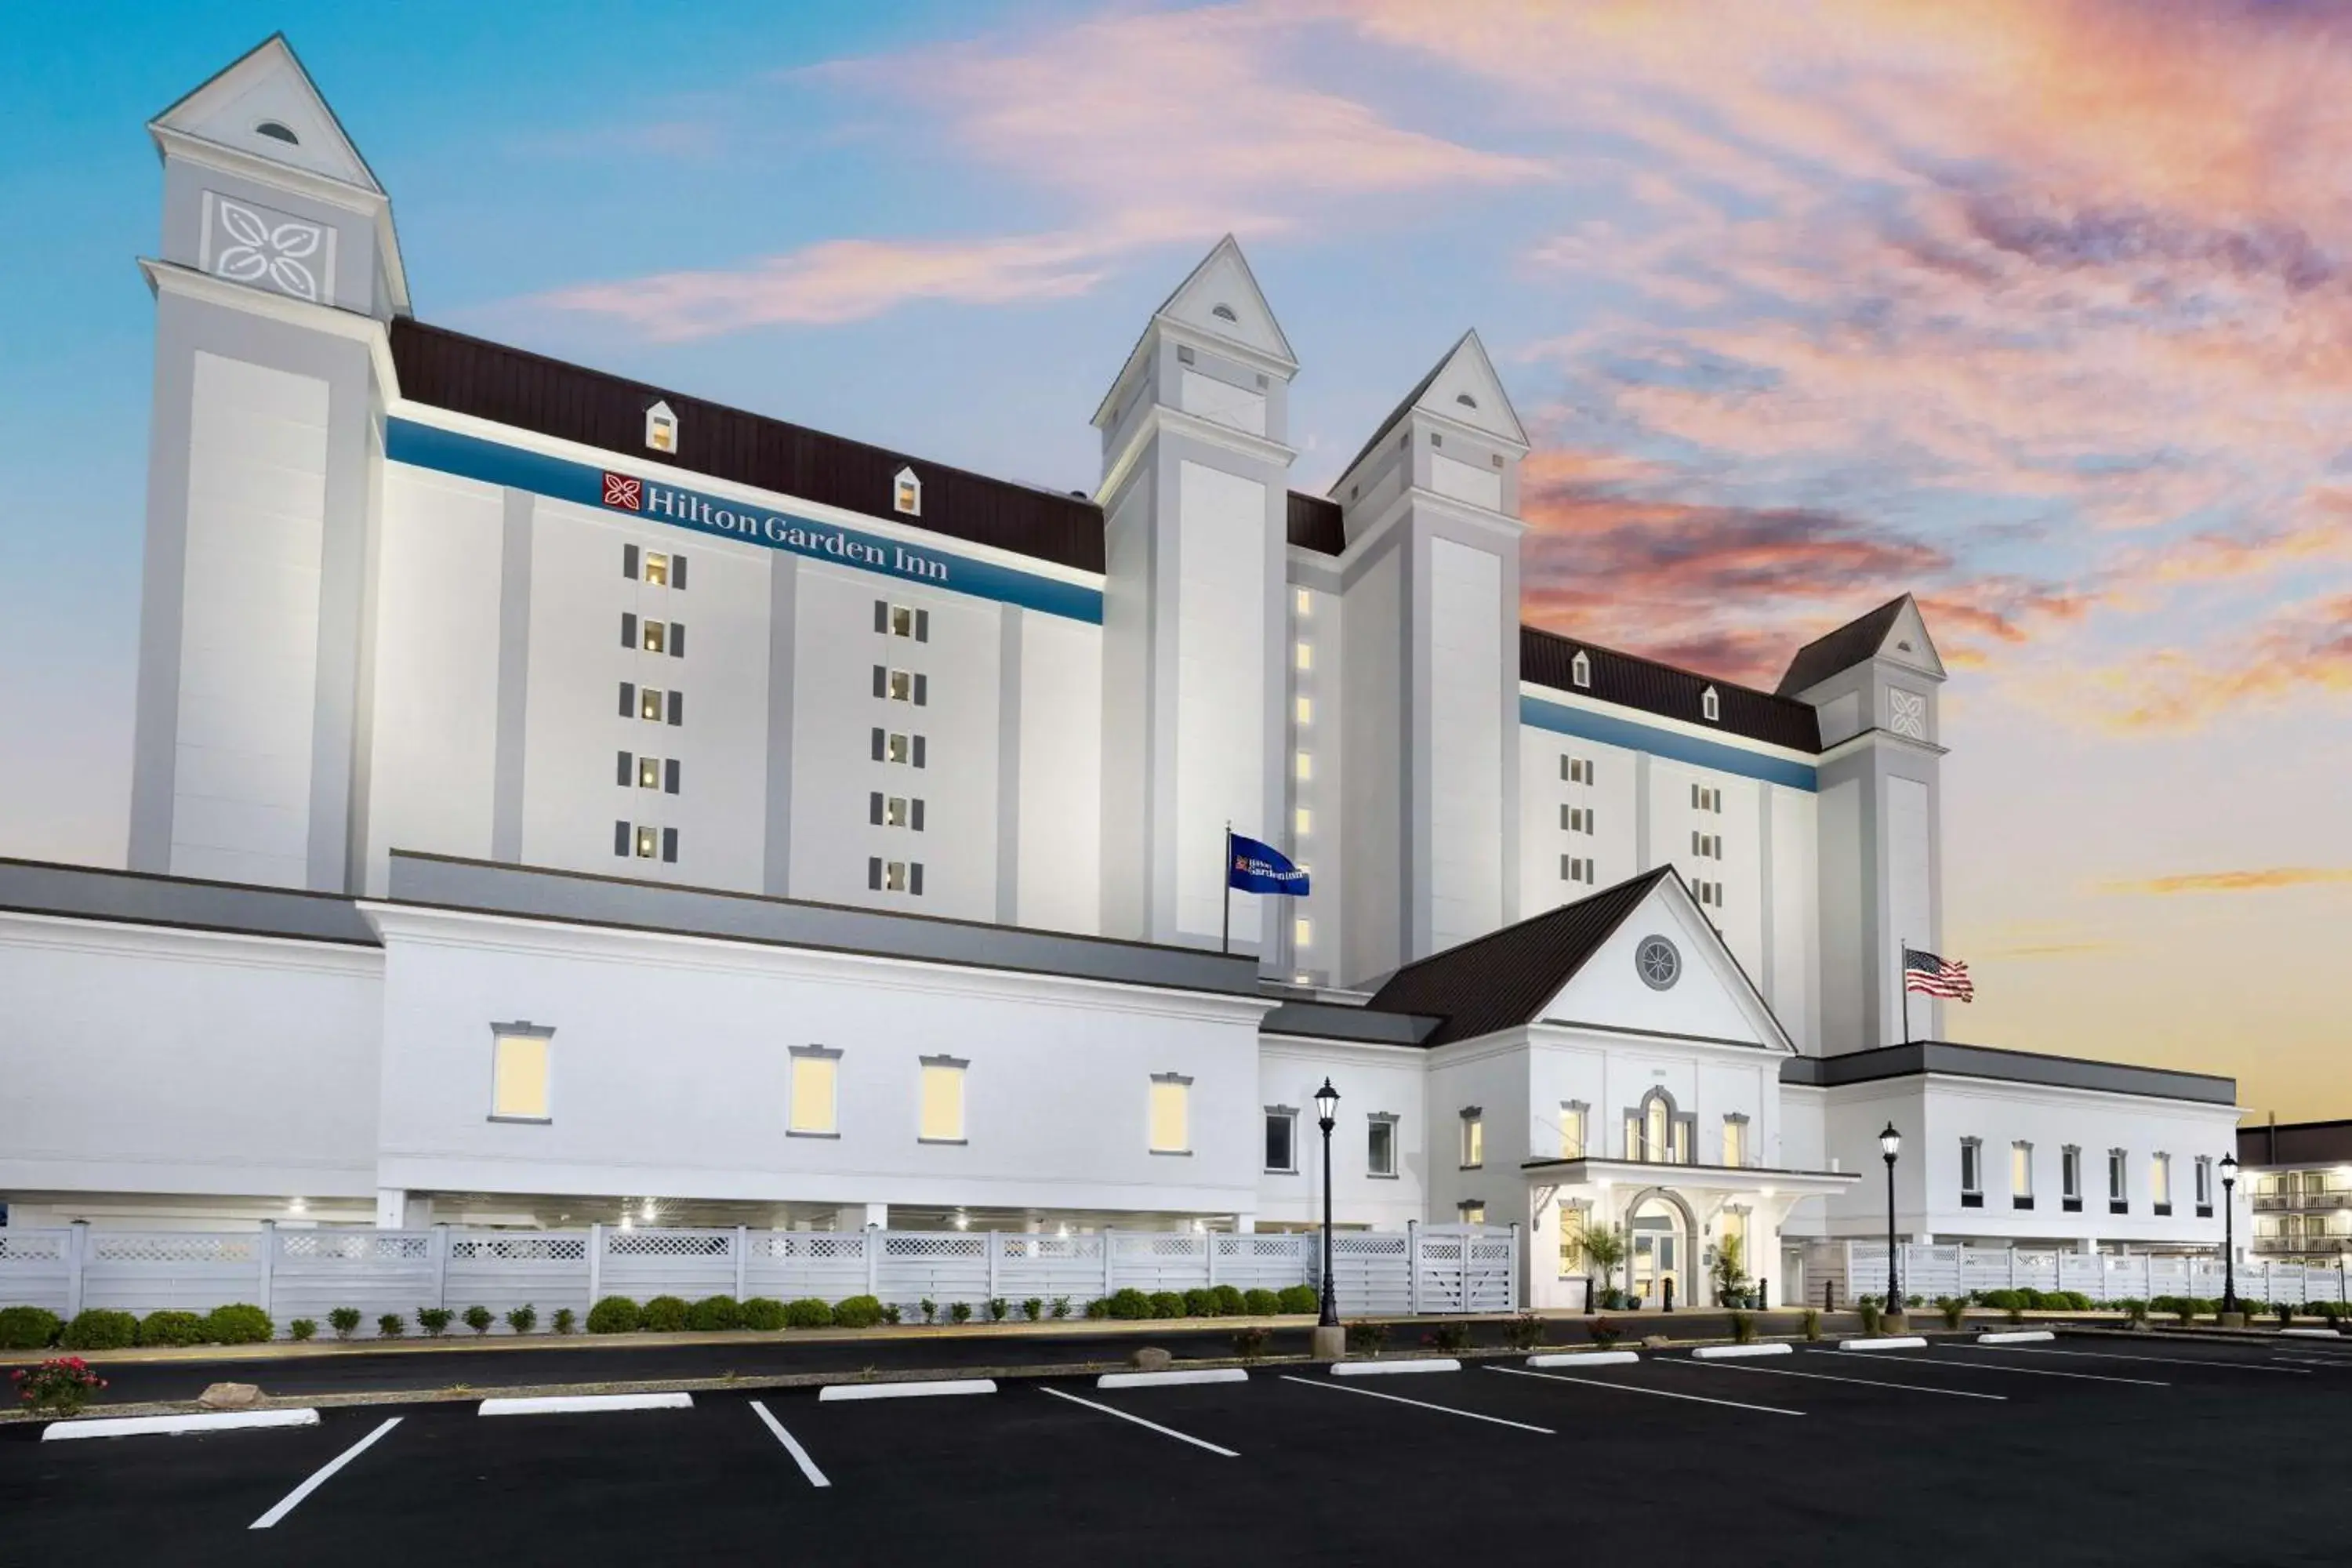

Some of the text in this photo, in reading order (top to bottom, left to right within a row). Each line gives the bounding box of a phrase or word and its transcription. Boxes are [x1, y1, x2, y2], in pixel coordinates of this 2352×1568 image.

[648, 487, 949, 582] Hilton Garden Inn
